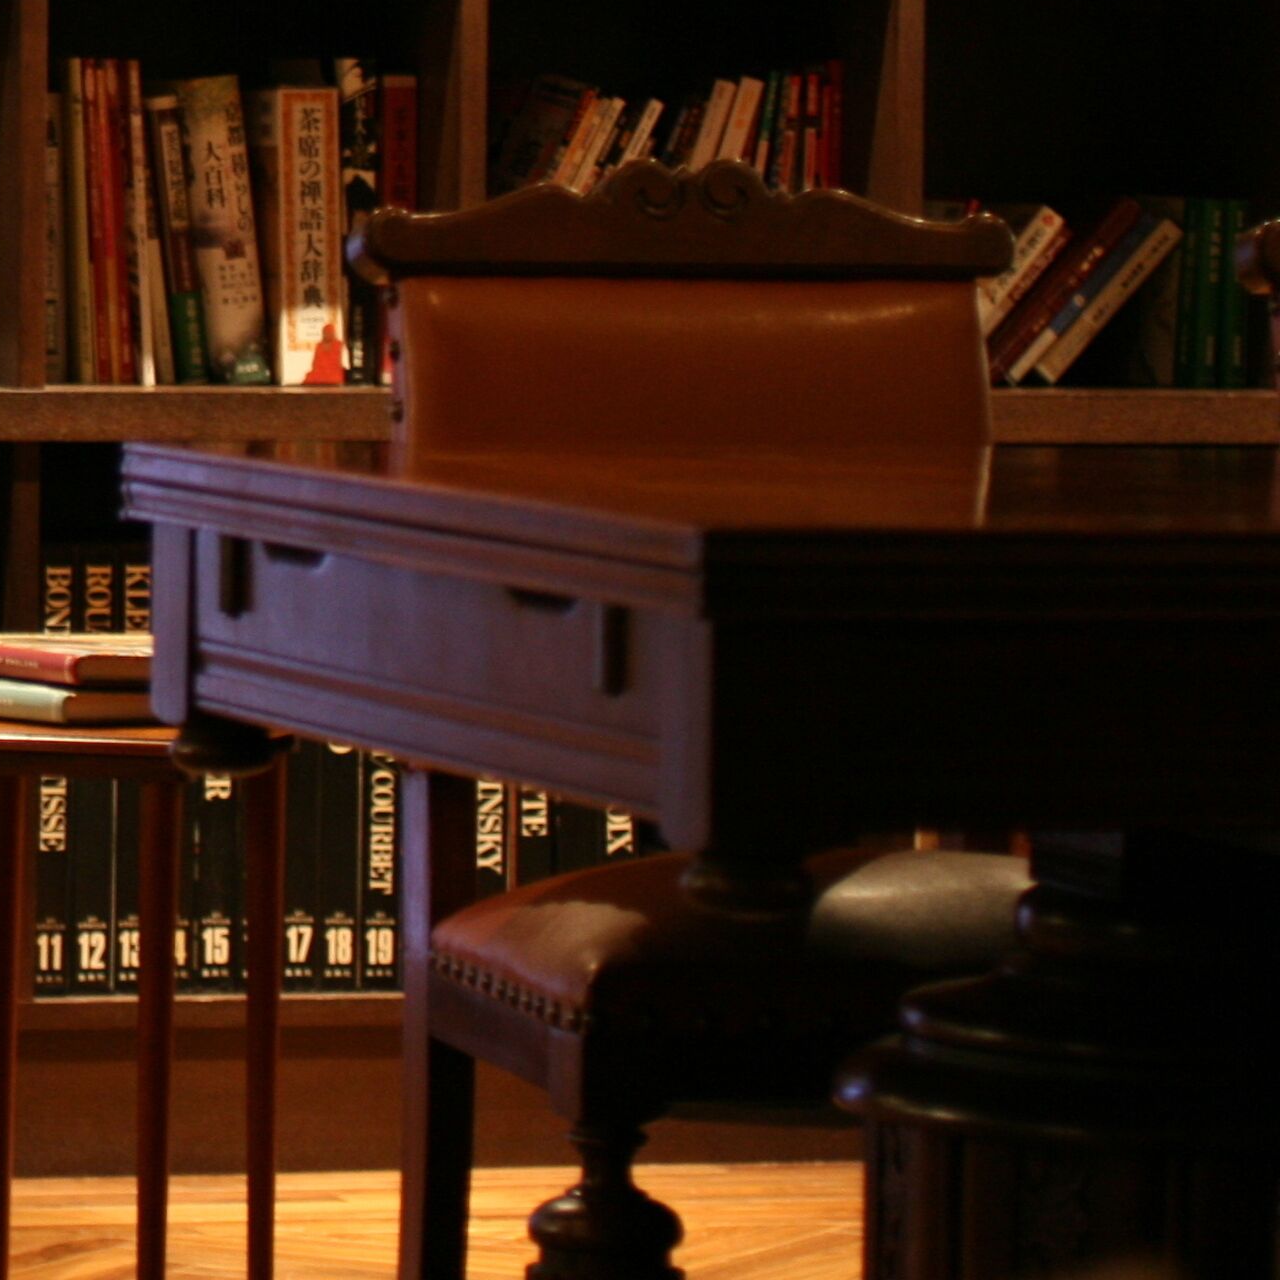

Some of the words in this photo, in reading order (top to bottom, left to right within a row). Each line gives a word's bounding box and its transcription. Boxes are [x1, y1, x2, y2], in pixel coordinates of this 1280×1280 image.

[203, 140, 228, 210] 大百科
[298, 108, 324, 308] 茶席の禅語大辞典
[44, 565, 72, 634] BON
[36, 932, 63, 971] 11
[77, 930, 106, 970] 12
[173, 928, 187, 967] 4
[201, 926, 230, 965] 15
[285, 924, 314, 963] 17
[325, 926, 353, 966] 18
[365, 926, 394, 966] 19
